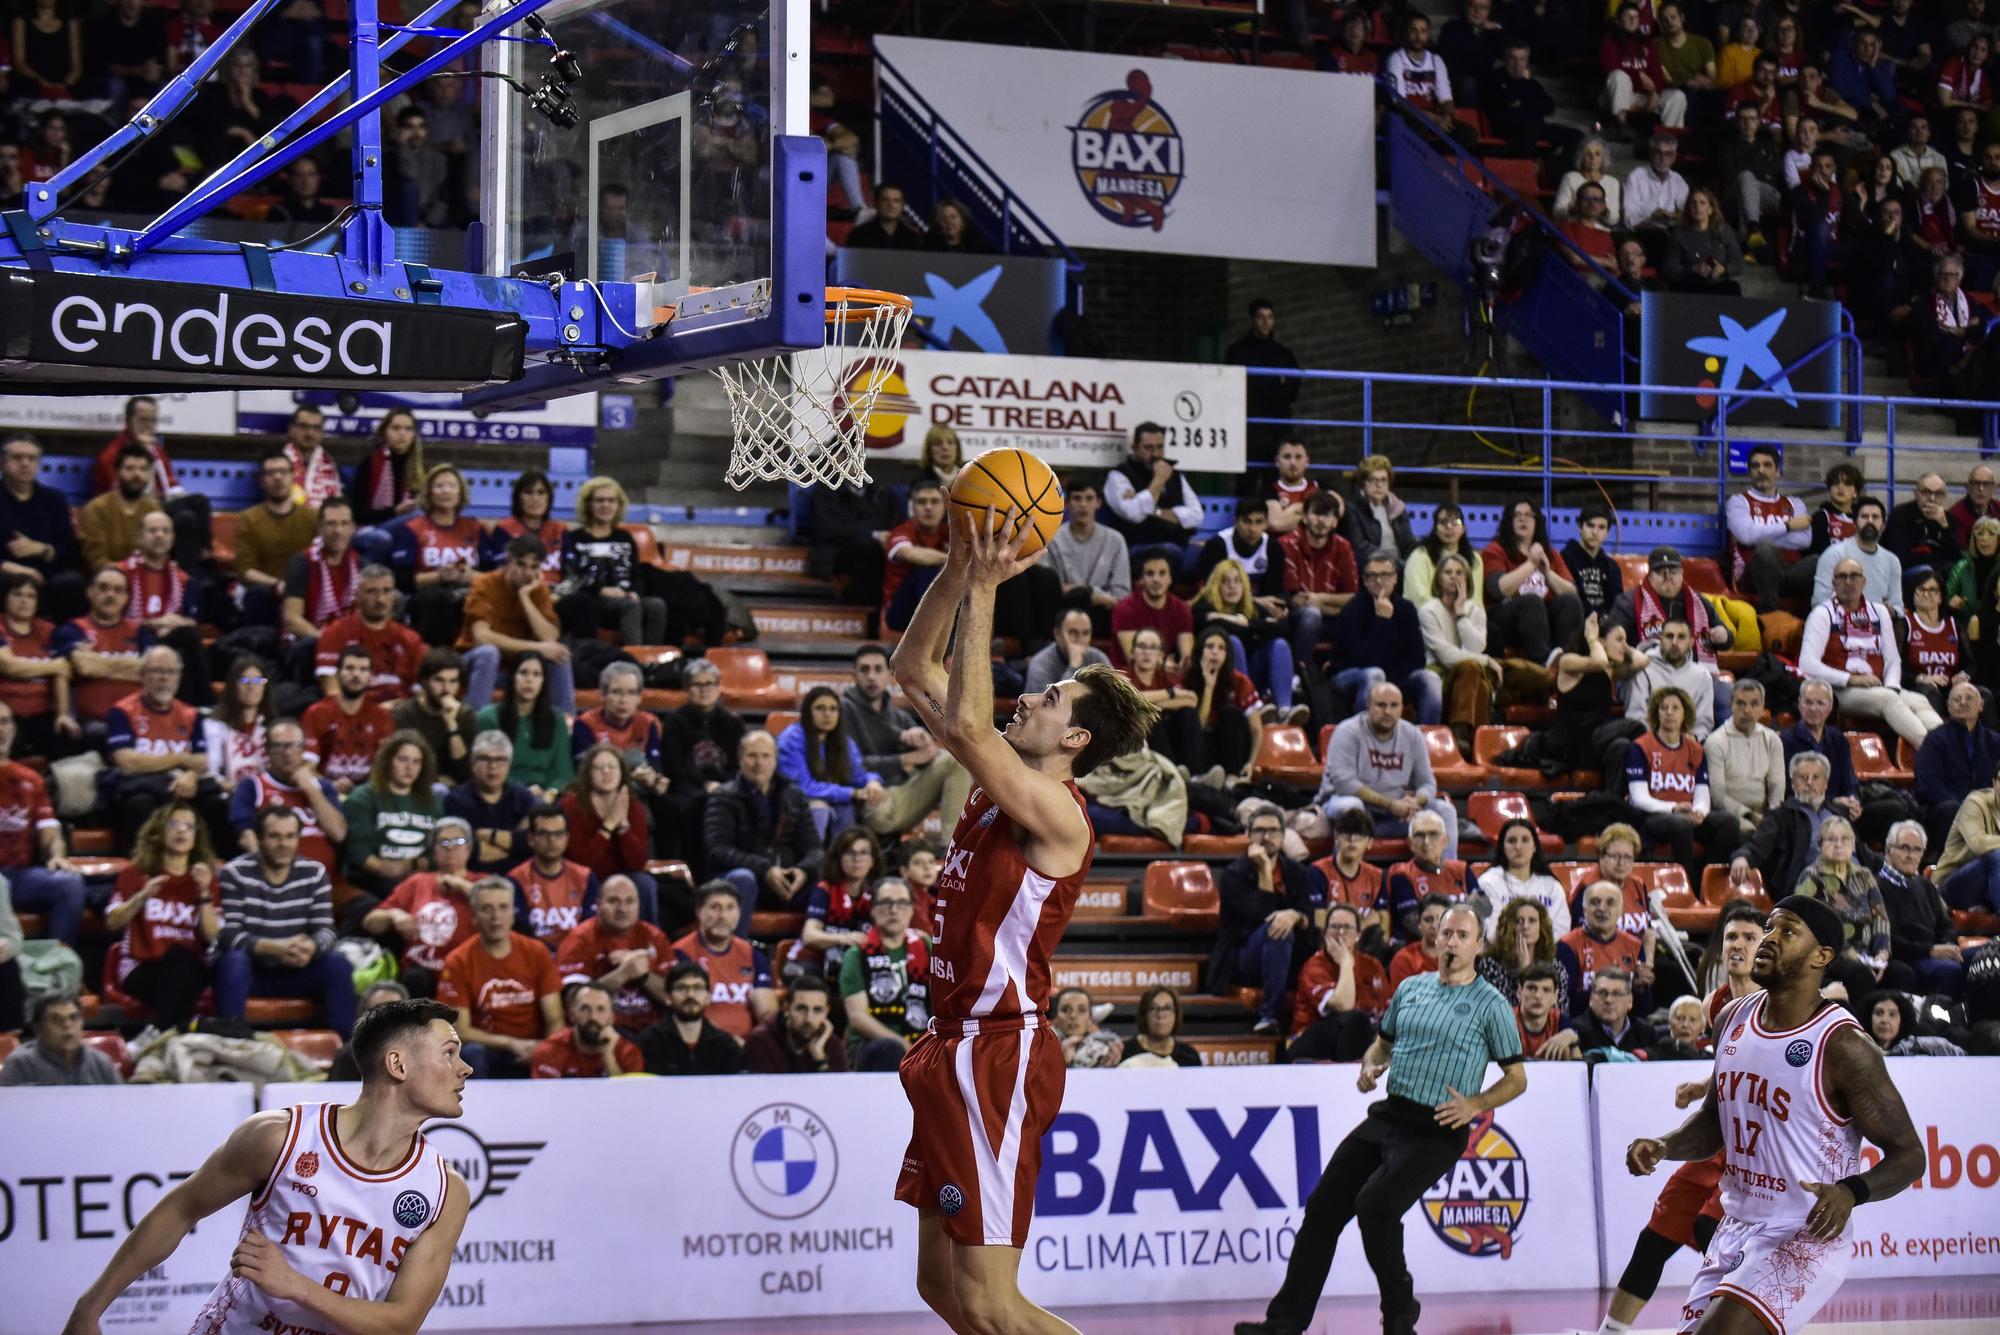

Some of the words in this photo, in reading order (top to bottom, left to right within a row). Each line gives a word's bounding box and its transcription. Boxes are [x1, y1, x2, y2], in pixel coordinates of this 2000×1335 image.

[1076, 130, 1180, 174] BAXI
[1096, 177, 1165, 199] MANRESA
[52, 293, 392, 375] endesa
[930, 375, 1125, 405] CATALANA
[610, 407, 626, 428] 3
[931, 403, 973, 426] DE
[981, 405, 1127, 432] TREBALL
[1183, 426, 1204, 448] 36
[763, 558, 804, 572] BAGE
[1919, 651, 1955, 666] BAXI
[1075, 892, 1121, 908] AGES
[1056, 970, 1132, 987] NETEGES
[1136, 971, 1191, 987] BAGES
[1214, 1051, 1269, 1066] BAGES
[1718, 1071, 1791, 1122] RYTAS
[745, 1109, 822, 1141] BMW
[1733, 1117, 1763, 1157] 17
[1034, 1105, 1322, 1218] BAXI
[1442, 1205, 1512, 1228] MANRESA
[280, 1211, 413, 1273] RYTAS
[452, 1239, 556, 1264] MUNICH
[683, 1231, 783, 1258] MOTOR
[790, 1226, 893, 1253] MUNICH
[1880, 1231, 1898, 1257] &
[439, 1278, 486, 1307] ADÍ
[760, 1263, 823, 1295] CADÍ
